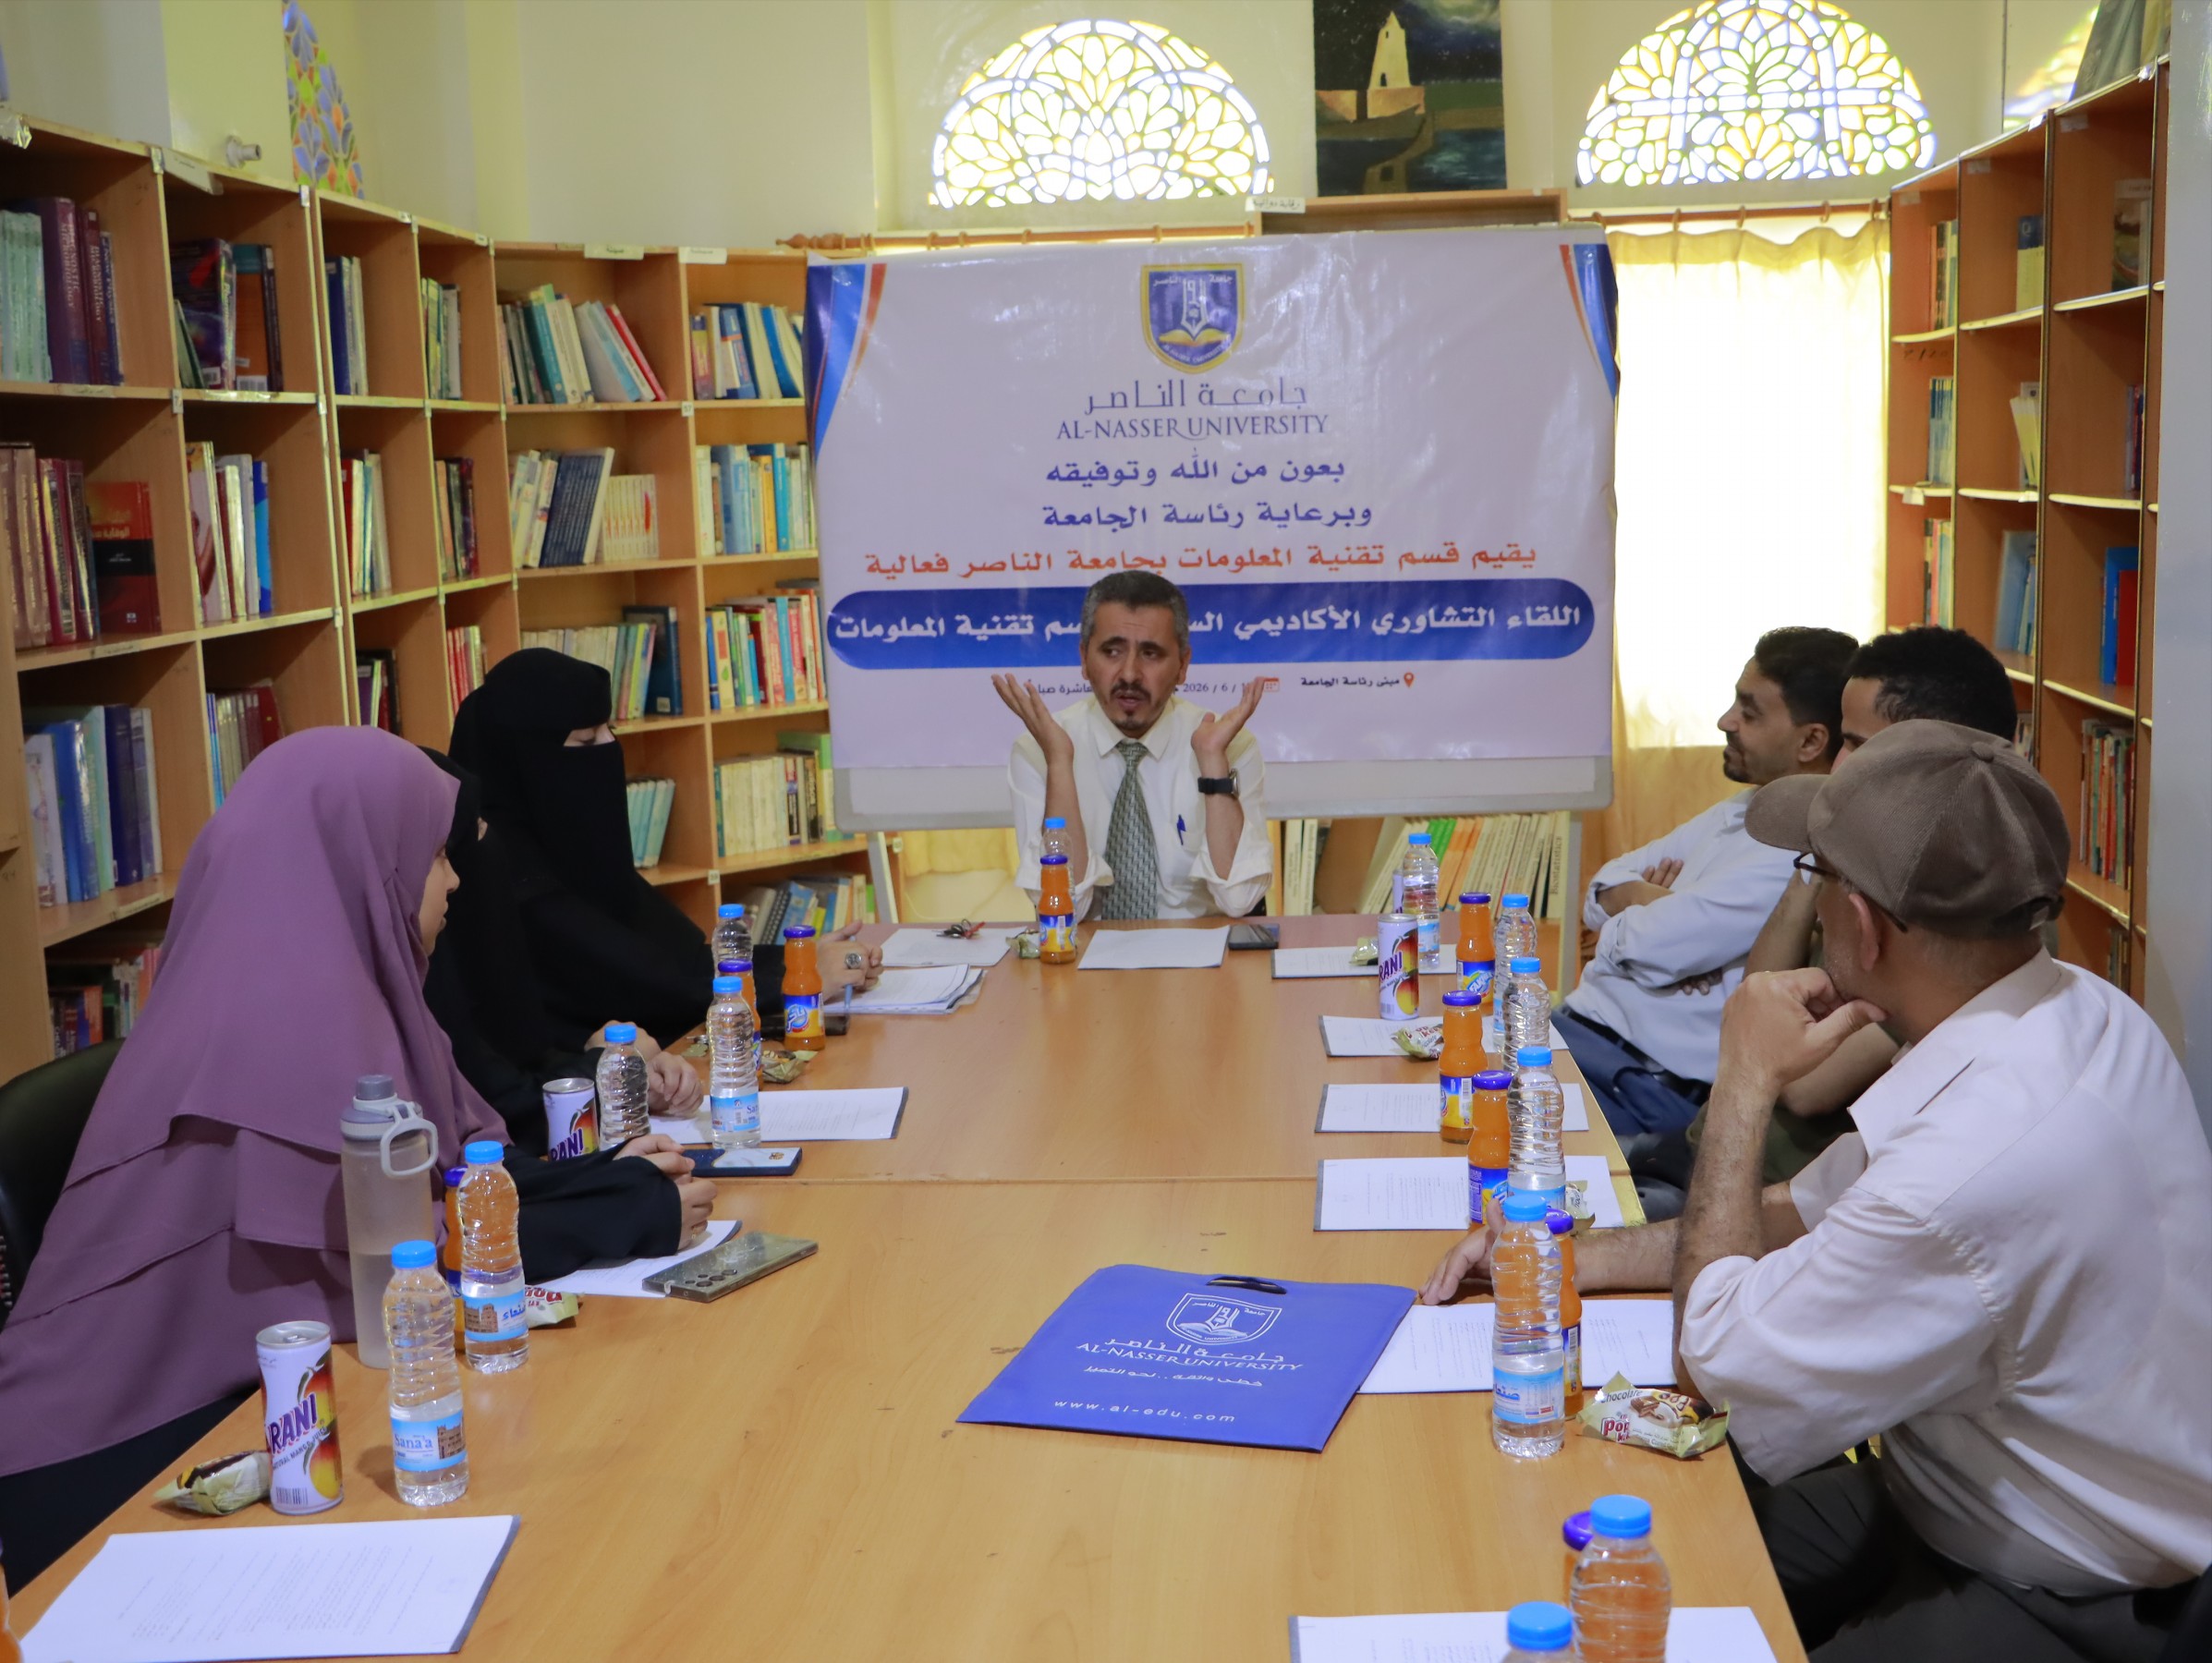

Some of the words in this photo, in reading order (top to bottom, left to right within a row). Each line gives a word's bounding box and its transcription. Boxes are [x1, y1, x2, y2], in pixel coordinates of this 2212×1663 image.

[1085, 379, 1185, 416] الناصر
[1198, 377, 1307, 409] جامعة
[1057, 419, 1185, 440] AL-NASSER
[1188, 415, 1329, 440] UNIVERSITY
[1046, 461, 1157, 488] وتوفيقه
[1232, 460, 1267, 484] من
[1280, 460, 1344, 482] بعون
[1042, 505, 1147, 533] الجامعة
[1162, 503, 1244, 528] رئاسة
[1257, 502, 1371, 528] وبرعاية
[865, 552, 950, 580] فعالية
[957, 552, 1052, 578] الناصر
[1066, 549, 1167, 577] بجامعة
[1178, 547, 1292, 573] المعلومات
[1307, 544, 1385, 572] تقنية
[1398, 542, 1460, 570] قسم
[1472, 543, 1536, 570] يقيم
[835, 616, 945, 643] المعلومات
[954, 614, 1034, 641] تقنية
[1234, 605, 1361, 640] الأكاديمي
[1371, 607, 1495, 636] التشاوري
[1507, 606, 1580, 630] اللقاء
[1183, 683, 1209, 693] 2026
[1221, 683, 1228, 692] 6
[1301, 676, 1339, 688] الجامعة
[1343, 676, 1373, 687] رئاسة
[1550, 835, 1562, 895] Biostatistics
[1379, 952, 1403, 981] RANI
[1245, 1307, 1266, 1316] جامعة
[1076, 1342, 1182, 1364] AL-NASSER
[1184, 1356, 1304, 1371] UNIVERSITY
[1105, 1339, 1191, 1355] الناصر
[1194, 1347, 1283, 1362] جامعة
[270, 1392, 318, 1454] RANI
[1053, 1400, 1235, 1423] www.al-edu.com
[290, 1441, 312, 1460] MANGO
[394, 1433, 433, 1450] Sana'a
